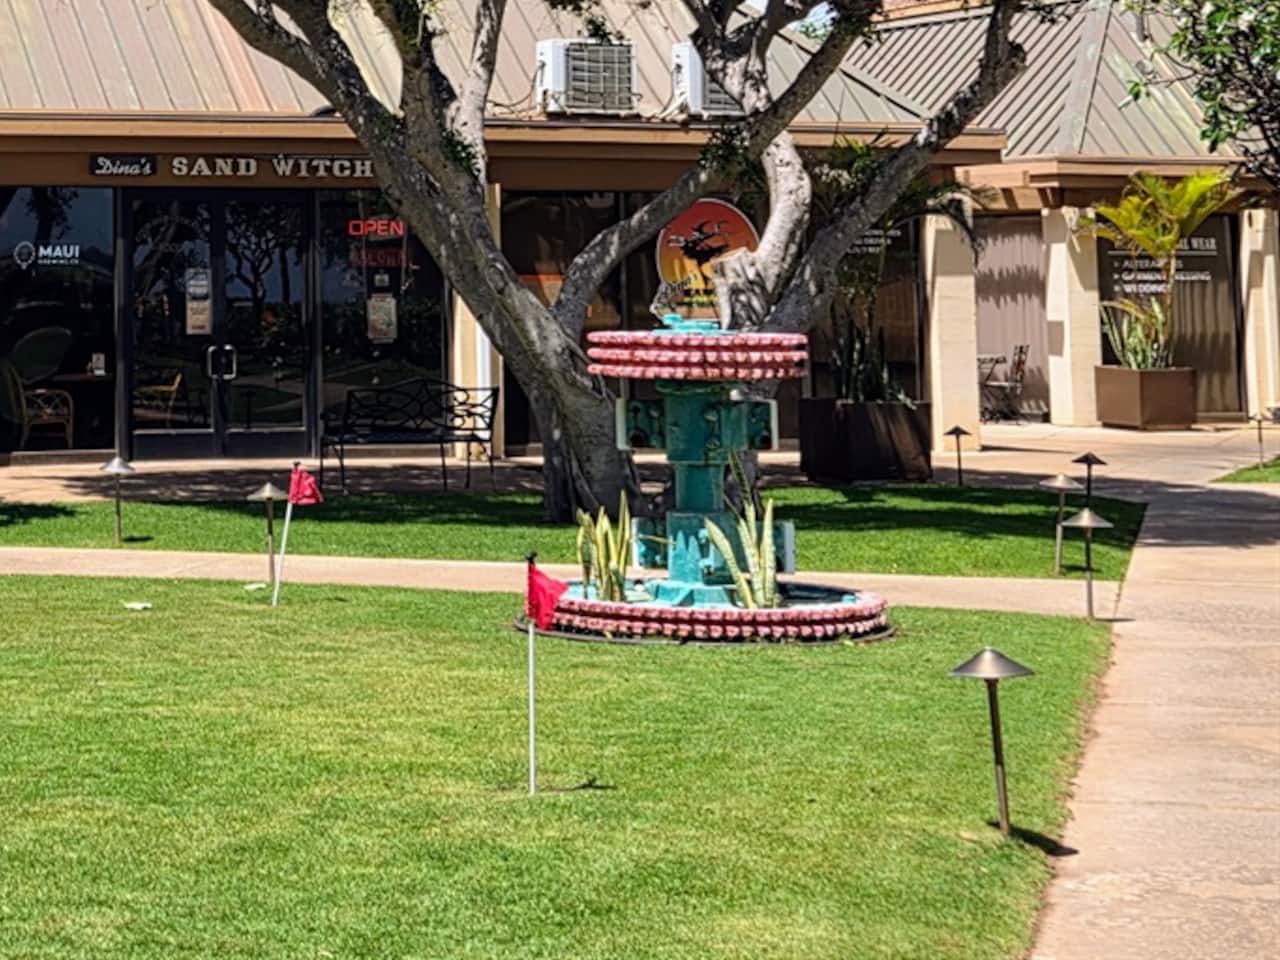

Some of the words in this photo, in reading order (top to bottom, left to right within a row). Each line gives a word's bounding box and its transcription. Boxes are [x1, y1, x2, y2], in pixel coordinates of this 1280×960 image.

[95, 156, 153, 175] Dina's
[172, 157, 257, 176] SAND
[273, 157, 374, 177] WITCH
[348, 220, 404, 236] OPEN
[38, 244, 80, 258] MAUI
